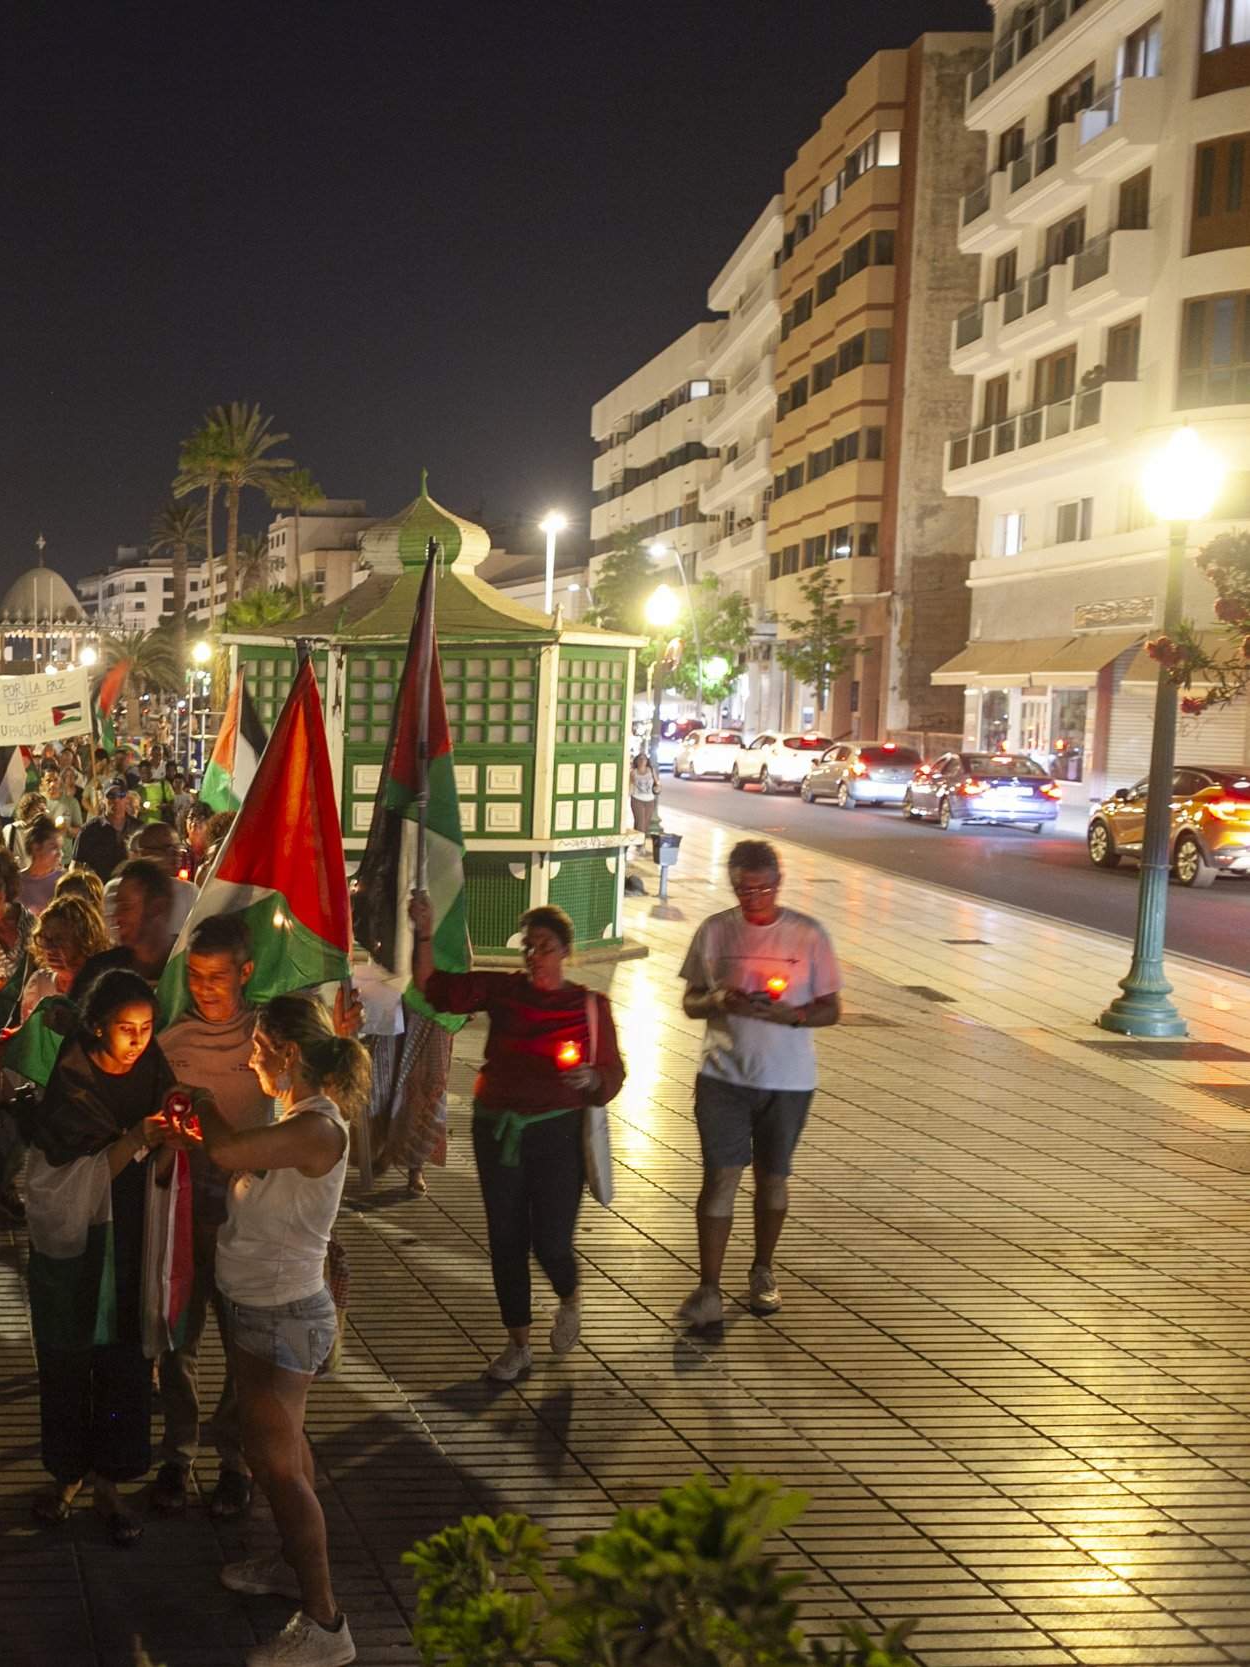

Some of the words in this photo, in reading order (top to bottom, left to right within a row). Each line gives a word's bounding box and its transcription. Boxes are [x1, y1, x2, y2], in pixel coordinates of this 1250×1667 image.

[2, 682, 23, 698] POR
[30, 681, 42, 695] LA
[46, 679, 65, 692] PAZ
[6, 699, 38, 716] LIBRE
